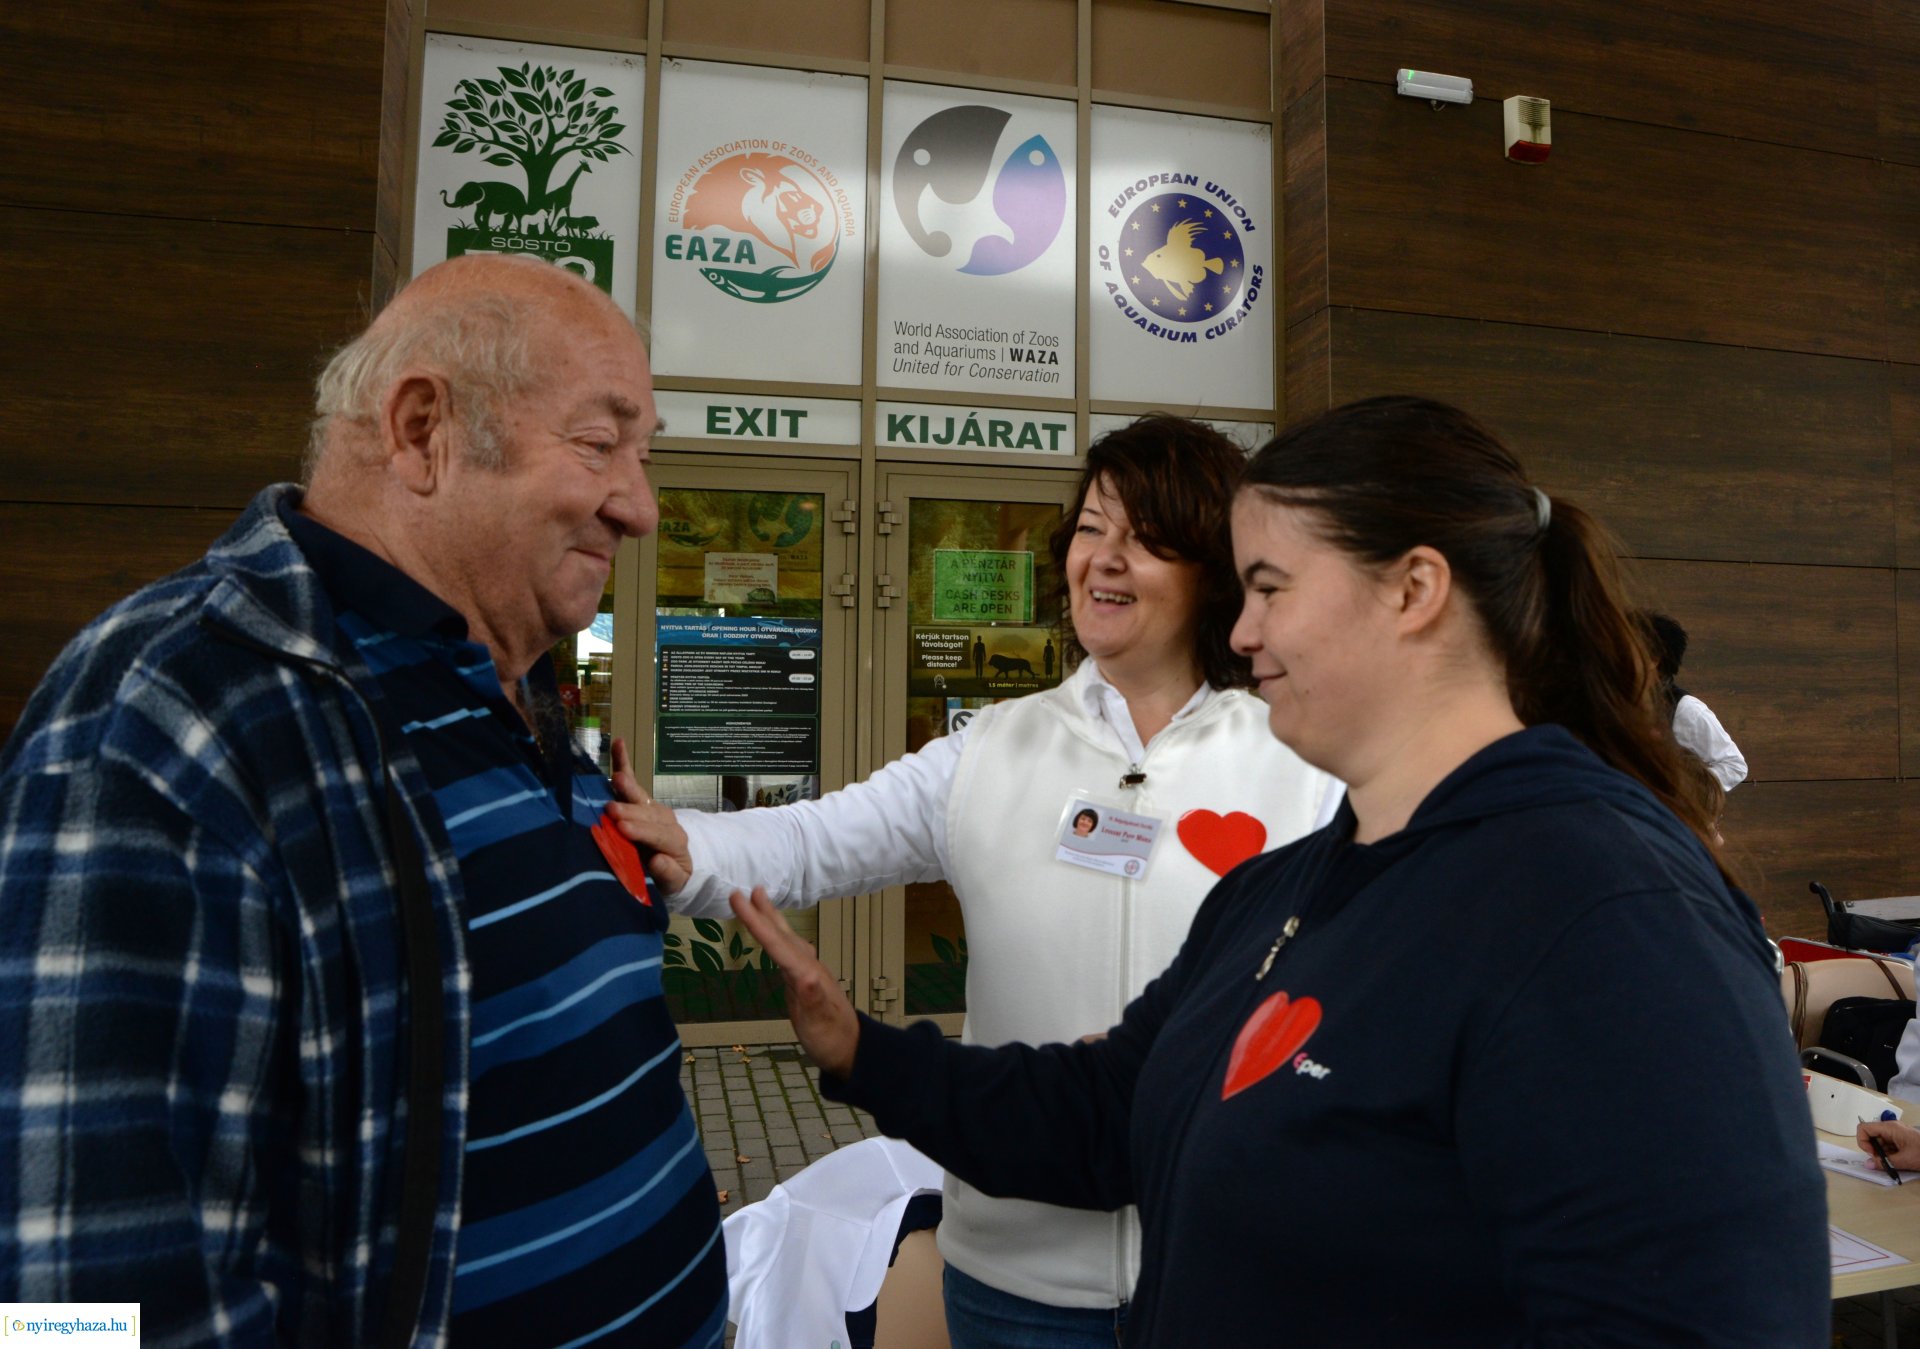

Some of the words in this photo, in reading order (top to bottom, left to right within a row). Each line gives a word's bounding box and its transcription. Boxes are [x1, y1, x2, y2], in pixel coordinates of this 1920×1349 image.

[668, 164, 700, 223] EUROPEAN
[699, 139, 769, 168] ASSOCIATION
[772, 141, 788, 152] OF
[789, 146, 819, 167] ZOOS
[817, 166, 838, 187] AND
[834, 188, 856, 237] AQUARIA
[1108, 173, 1199, 218] EUROPEAN
[1205, 181, 1256, 232] UNION
[491, 236, 571, 252] SÓSTÓ
[665, 234, 756, 264] EAZA
[1098, 245, 1112, 271] OF
[1105, 281, 1197, 343] AQUARIUM
[1205, 264, 1263, 340] CURATORS
[894, 321, 932, 337] World
[935, 323, 1008, 343] Association
[1013, 331, 1025, 344] of
[1029, 331, 1059, 348] Zoos
[894, 341, 919, 355] and
[924, 341, 996, 360] Aquariums
[1010, 348, 1059, 365] WAZA
[892, 358, 939, 375] United
[944, 361, 965, 376] for
[969, 363, 1060, 383] Conservation
[706, 405, 808, 438] EXIT
[887, 412, 1067, 451] KIJÁRAT
[950, 559, 959, 569] A
[963, 573, 1005, 583] NYITVA
[945, 589, 978, 600] CASH
[981, 590, 1020, 601] DESKS
[953, 603, 977, 613] ARE
[980, 603, 1013, 614] OPEN
[945, 654, 962, 662] keep
